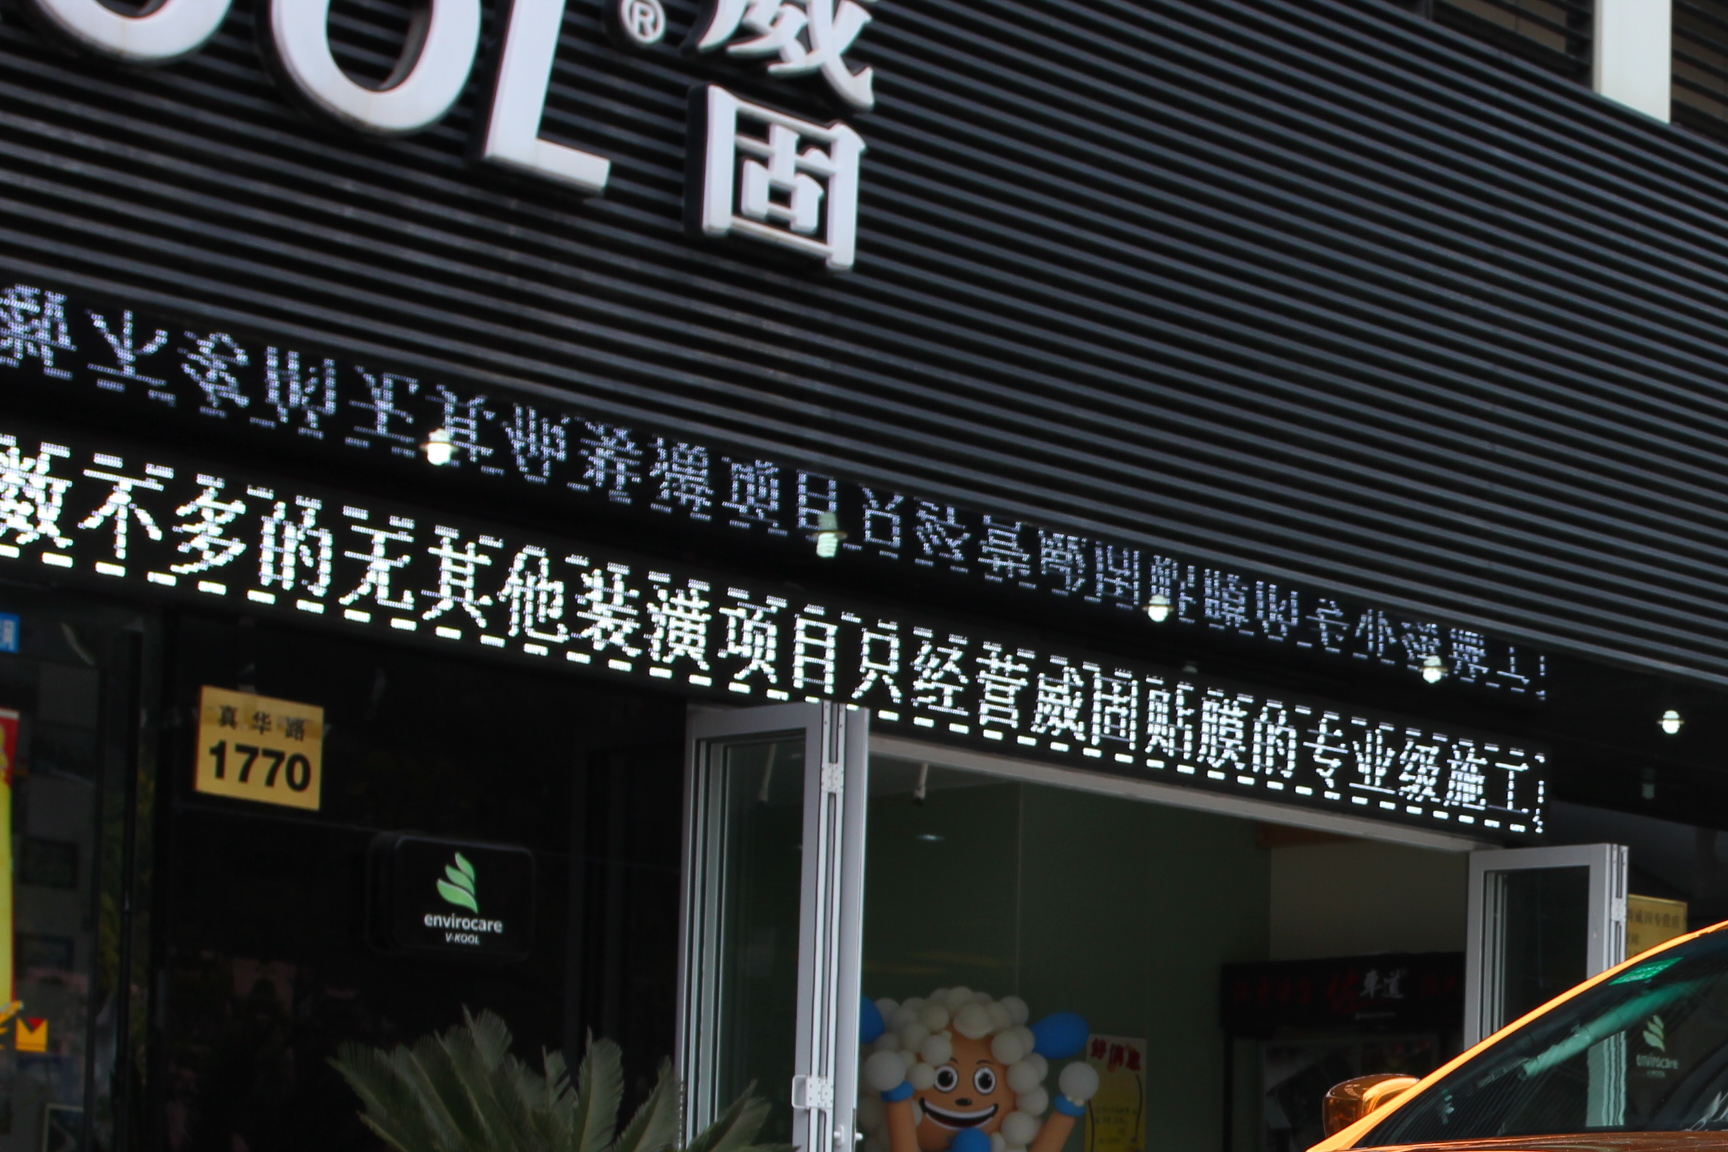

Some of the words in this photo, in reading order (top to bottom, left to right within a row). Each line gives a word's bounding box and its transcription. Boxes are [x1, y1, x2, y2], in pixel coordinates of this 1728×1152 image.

[0, 440, 1546, 834] 数不多的无其他装潢项目只经营威固贴膜的专业级施工
[219, 704, 305, 742] 真华路
[209, 740, 312, 793] 1770
[423, 913, 504, 934] envirocare
[445, 932, 481, 945] V-KOOL
